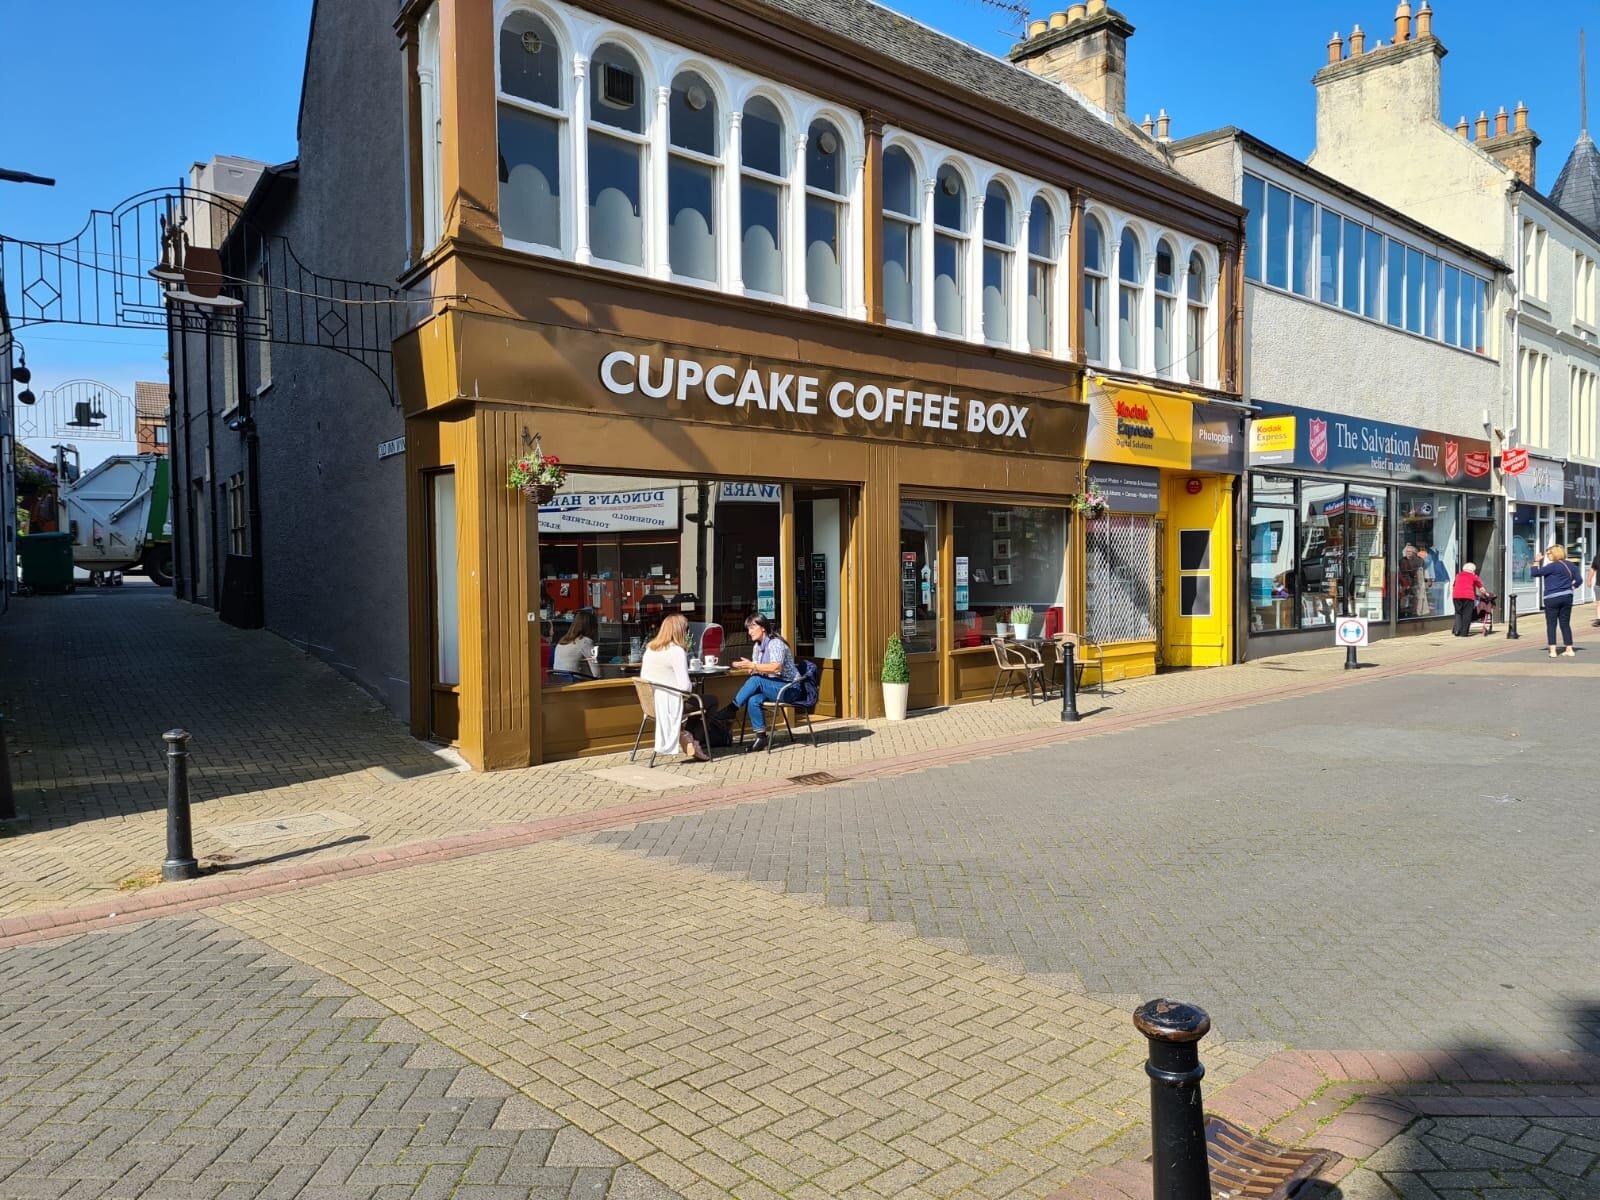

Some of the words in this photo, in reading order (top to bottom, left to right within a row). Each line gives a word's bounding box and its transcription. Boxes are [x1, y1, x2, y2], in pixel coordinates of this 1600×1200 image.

[600, 350, 818, 414] CUPCAKE
[829, 382, 960, 430] COFFEE
[968, 400, 1028, 438] BOX
[1116, 400, 1148, 420] Kodak
[1257, 424, 1282, 433] Kodak
[1132, 441, 1152, 449] Solutions
[1199, 429, 1233, 445] Photopoint
[1257, 433, 1287, 441] Express
[1335, 423, 1358, 449] The
[1361, 427, 1411, 456] Salvation
[1413, 436, 1440, 467] Army
[1370, 456, 1387, 470] belief
[1388, 461, 1393, 471] in
[1395, 462, 1411, 473] action
